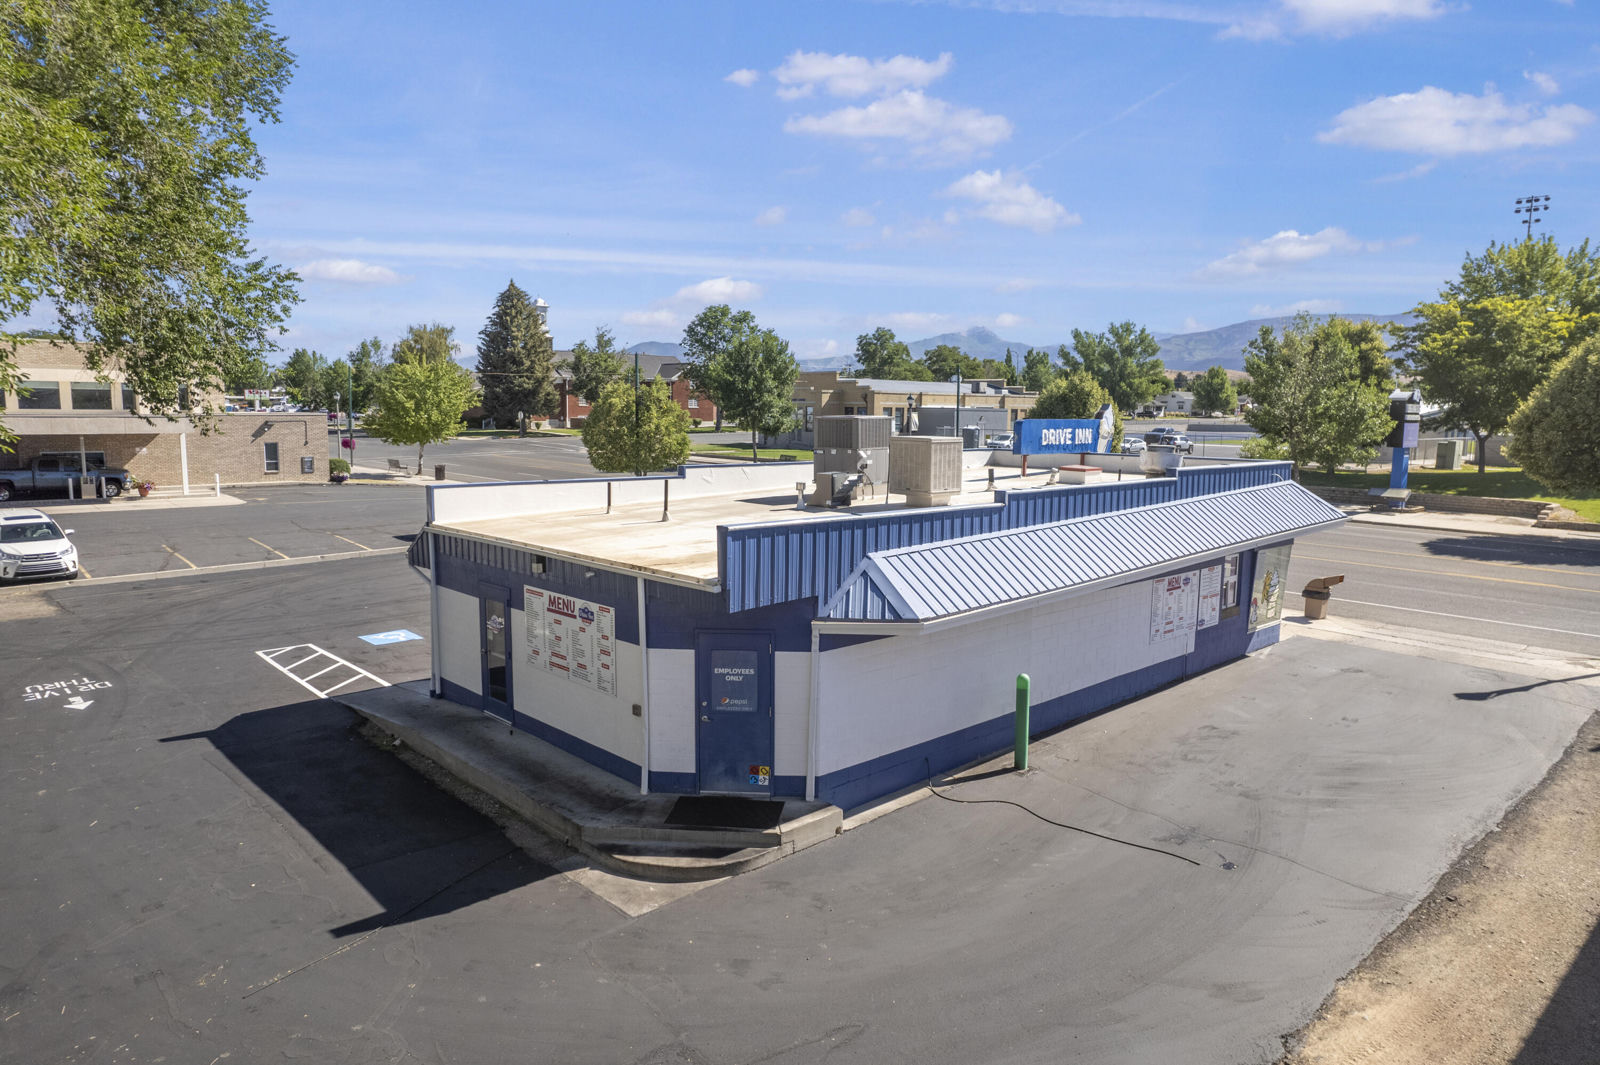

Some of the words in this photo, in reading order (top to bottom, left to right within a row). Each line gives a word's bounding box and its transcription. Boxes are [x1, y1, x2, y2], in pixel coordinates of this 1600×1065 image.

[1041, 427, 1073, 446] DRIVE
[1075, 427, 1093, 445] INN
[548, 594, 576, 613] MENU
[714, 667, 755, 675] EMPLOYEES
[22, 681, 113, 702] DRIVE
[25, 677, 96, 693] THRU
